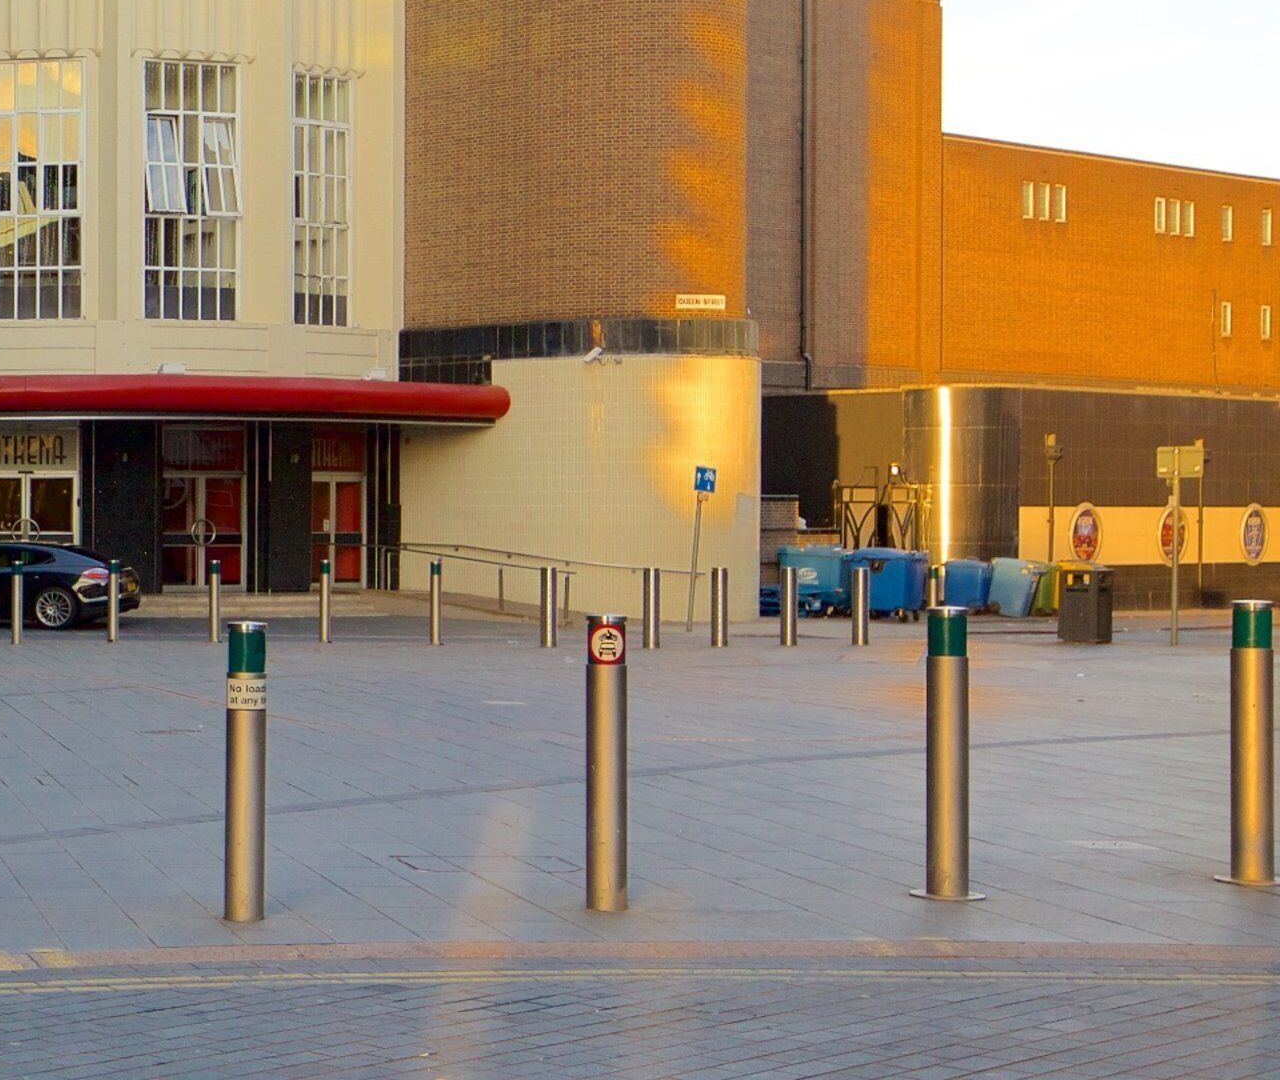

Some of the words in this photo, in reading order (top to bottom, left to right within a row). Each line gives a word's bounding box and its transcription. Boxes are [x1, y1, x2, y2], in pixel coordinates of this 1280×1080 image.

[229, 684, 242, 693] No
[230, 696, 238, 704] at
[240, 697, 258, 707] any
